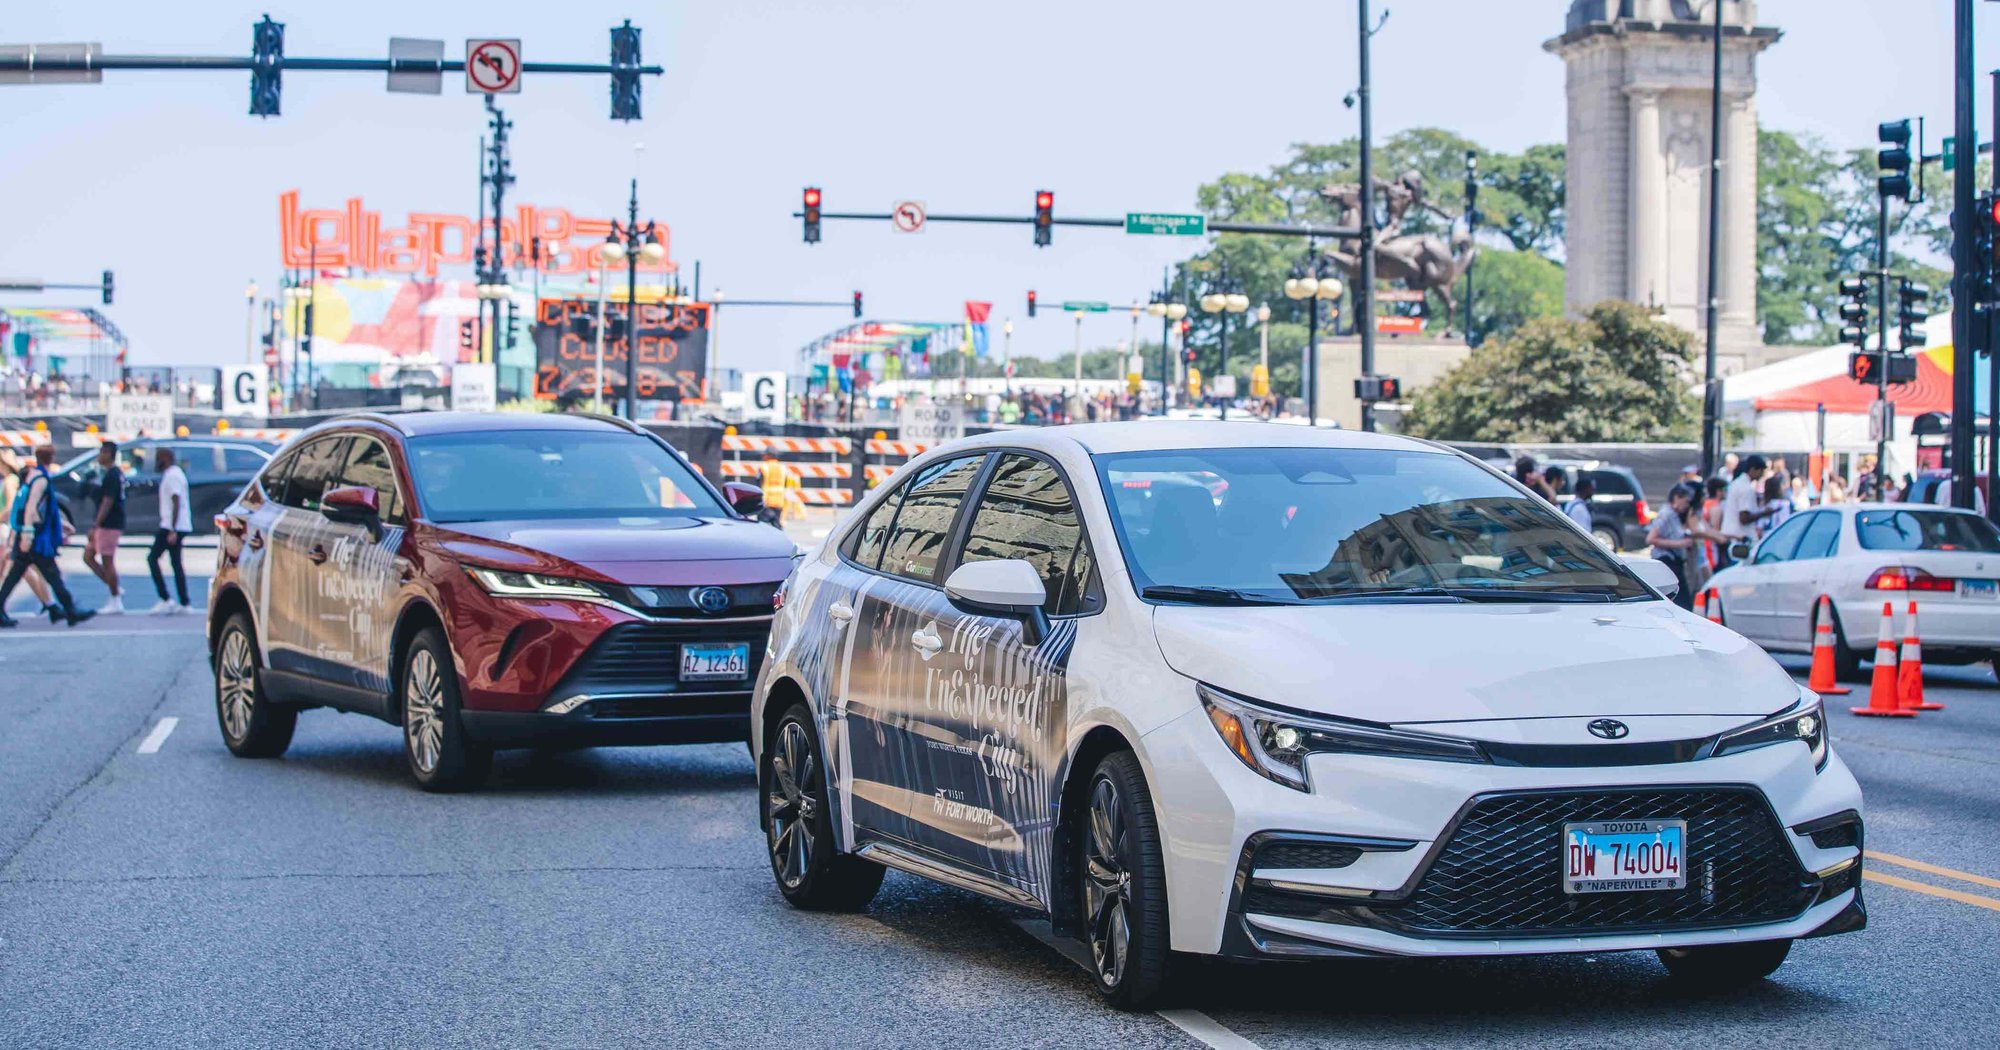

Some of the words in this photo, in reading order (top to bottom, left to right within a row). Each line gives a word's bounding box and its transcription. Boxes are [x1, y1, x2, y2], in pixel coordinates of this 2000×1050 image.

[543, 301, 698, 330] COBUS
[235, 372, 256, 403] G
[754, 377, 775, 409] G
[122, 401, 160, 413] ROAD
[914, 410, 950, 422] ROAD
[906, 426, 958, 438] CLOSED
[949, 614, 992, 671] The
[683, 655, 700, 672] AZ
[706, 654, 745, 672] 12361
[977, 728, 1017, 795] City
[948, 789, 964, 800] VISIT
[945, 801, 965, 819] FORT
[966, 805, 994, 826] WORTH
[1602, 823, 1648, 833] TOYOTA
[1569, 844, 1595, 876] DW
[1610, 842, 1678, 875] 74004
